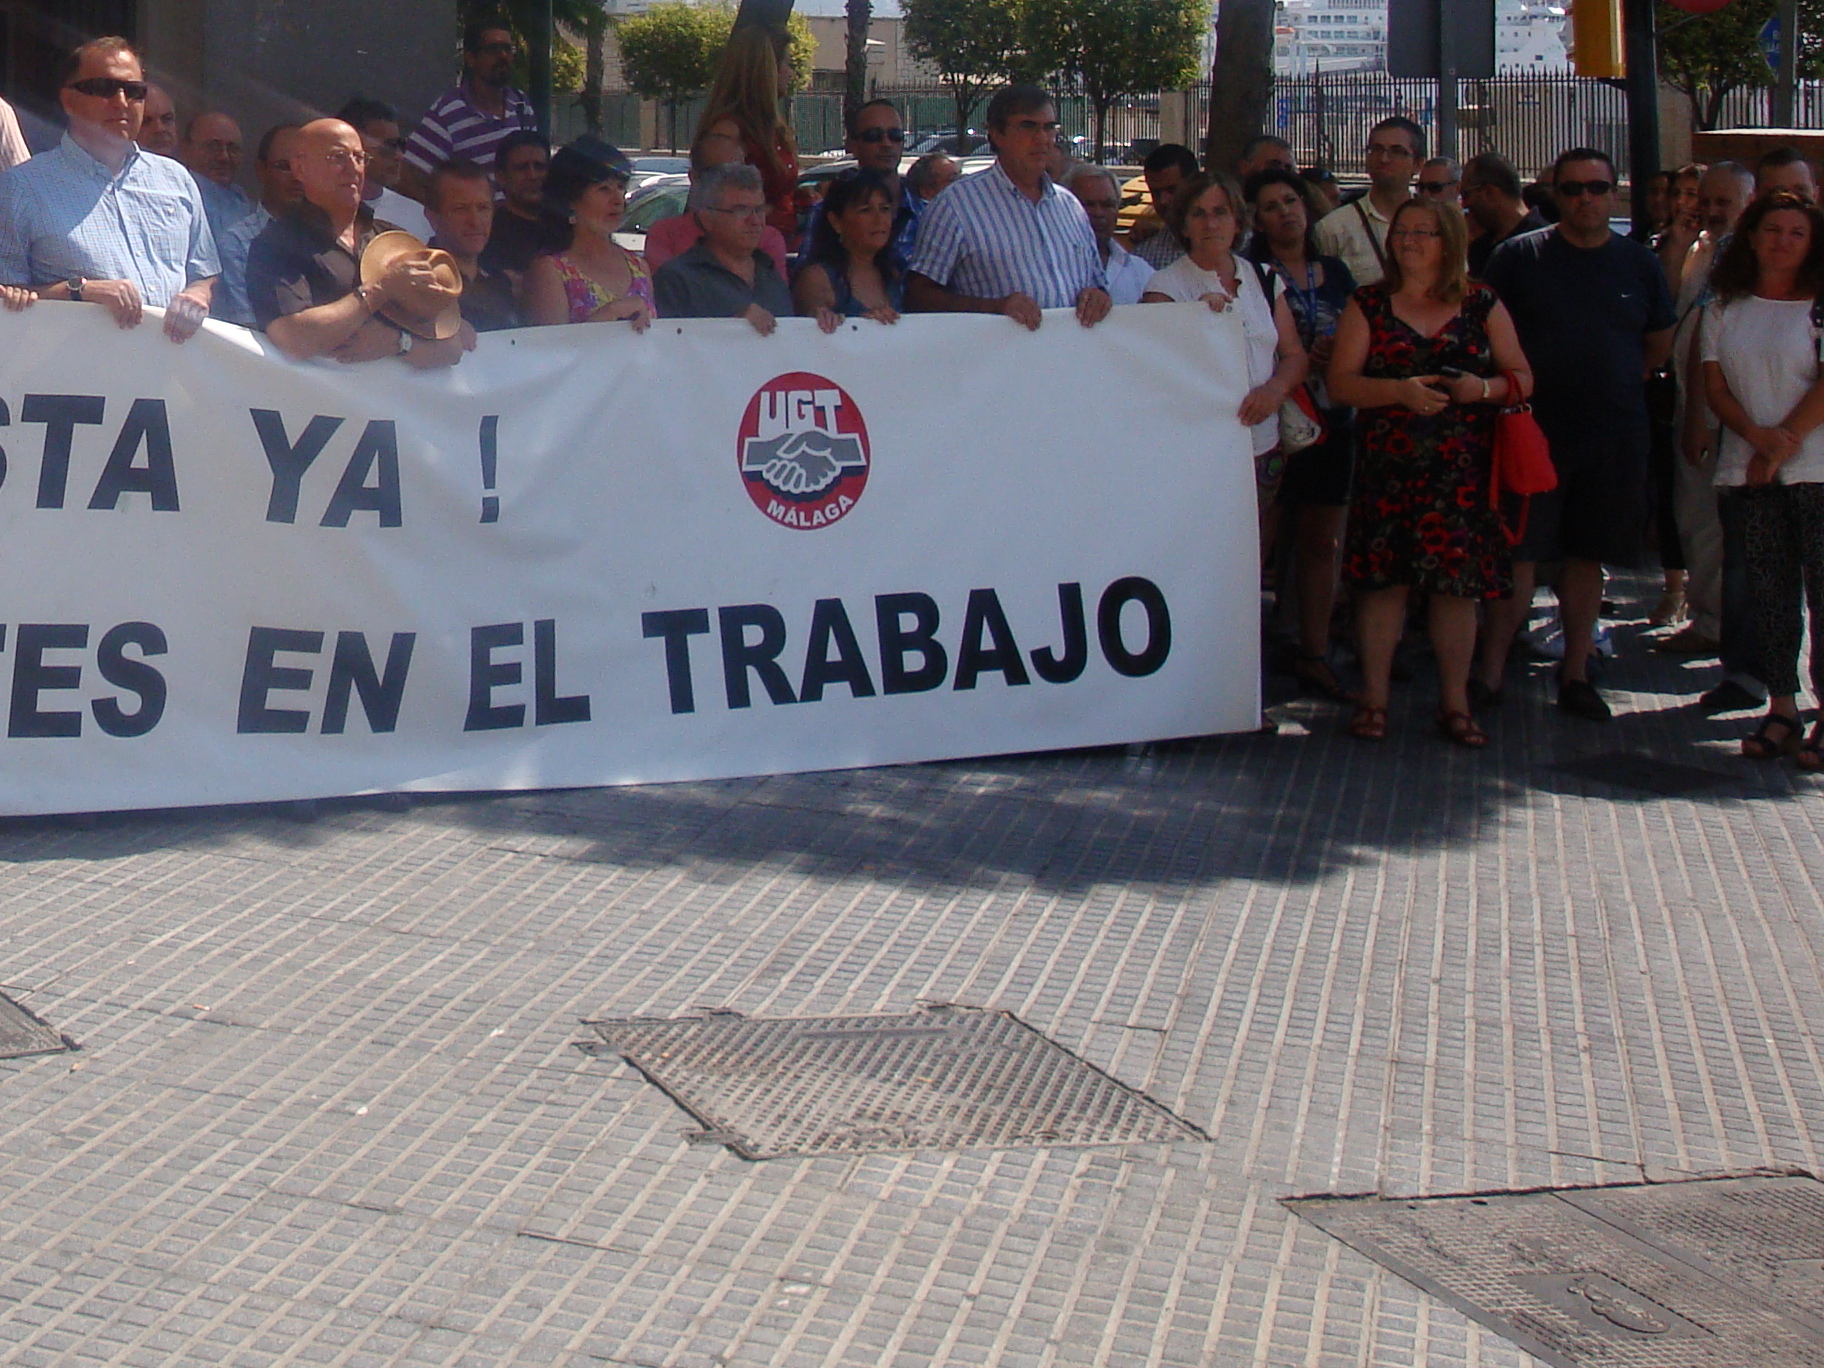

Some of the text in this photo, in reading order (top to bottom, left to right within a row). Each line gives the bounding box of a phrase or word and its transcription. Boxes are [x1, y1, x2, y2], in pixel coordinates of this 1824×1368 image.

[757, 388, 843, 438] UGT
[248, 407, 404, 529] YA
[766, 493, 854, 528] MÁLAGA
[236, 625, 417, 735] EN
[463, 617, 592, 732] EL
[641, 576, 1173, 715] TRABAJO
